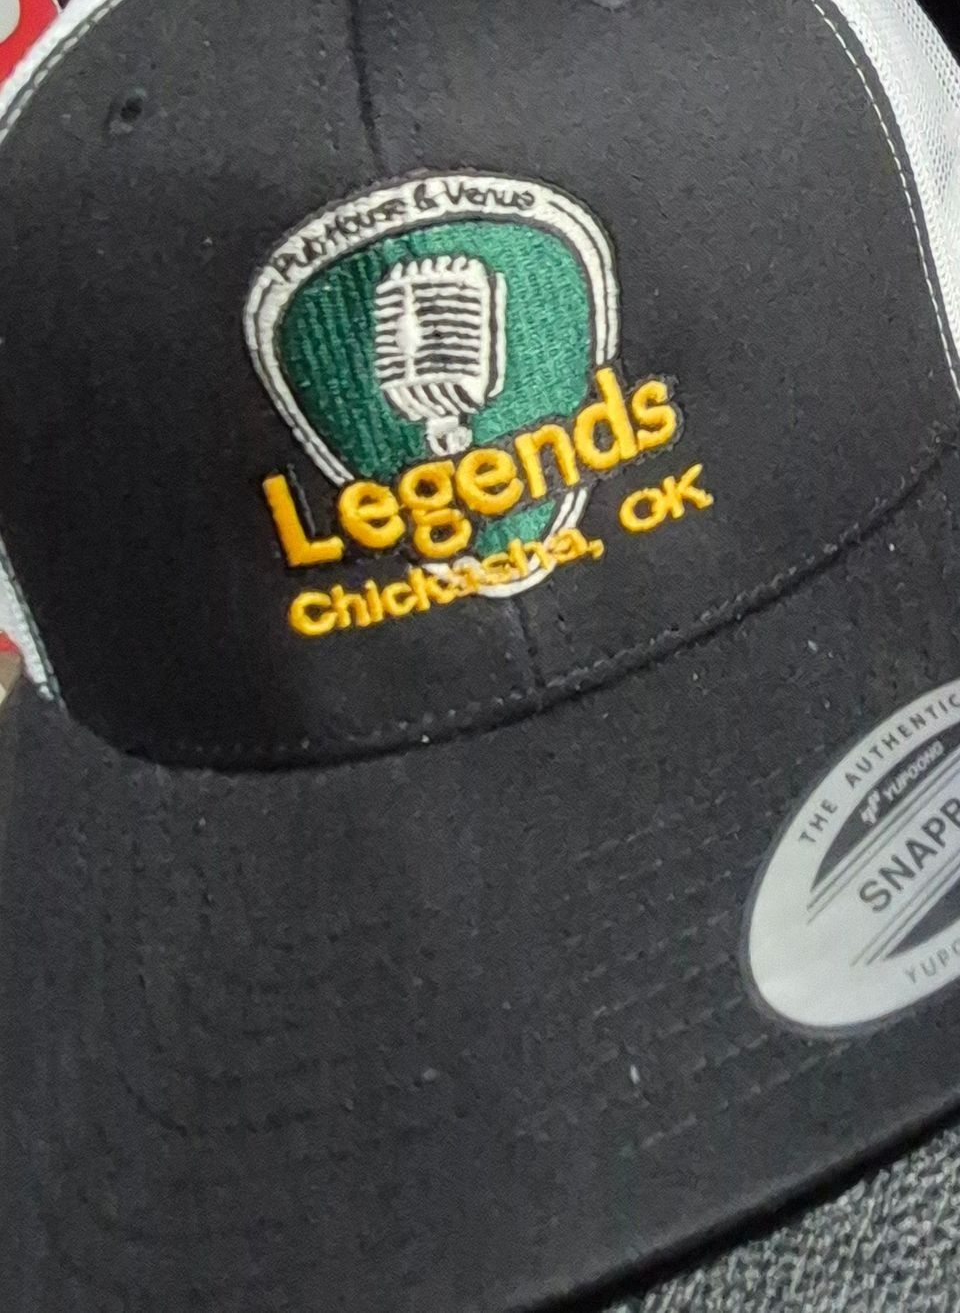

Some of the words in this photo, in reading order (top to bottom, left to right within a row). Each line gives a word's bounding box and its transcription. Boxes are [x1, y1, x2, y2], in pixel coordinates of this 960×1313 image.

[262, 366, 678, 568] Legends
[288, 527, 604, 637] Chickasha,
[618, 463, 714, 532] OK
[800, 799, 838, 845] THE
